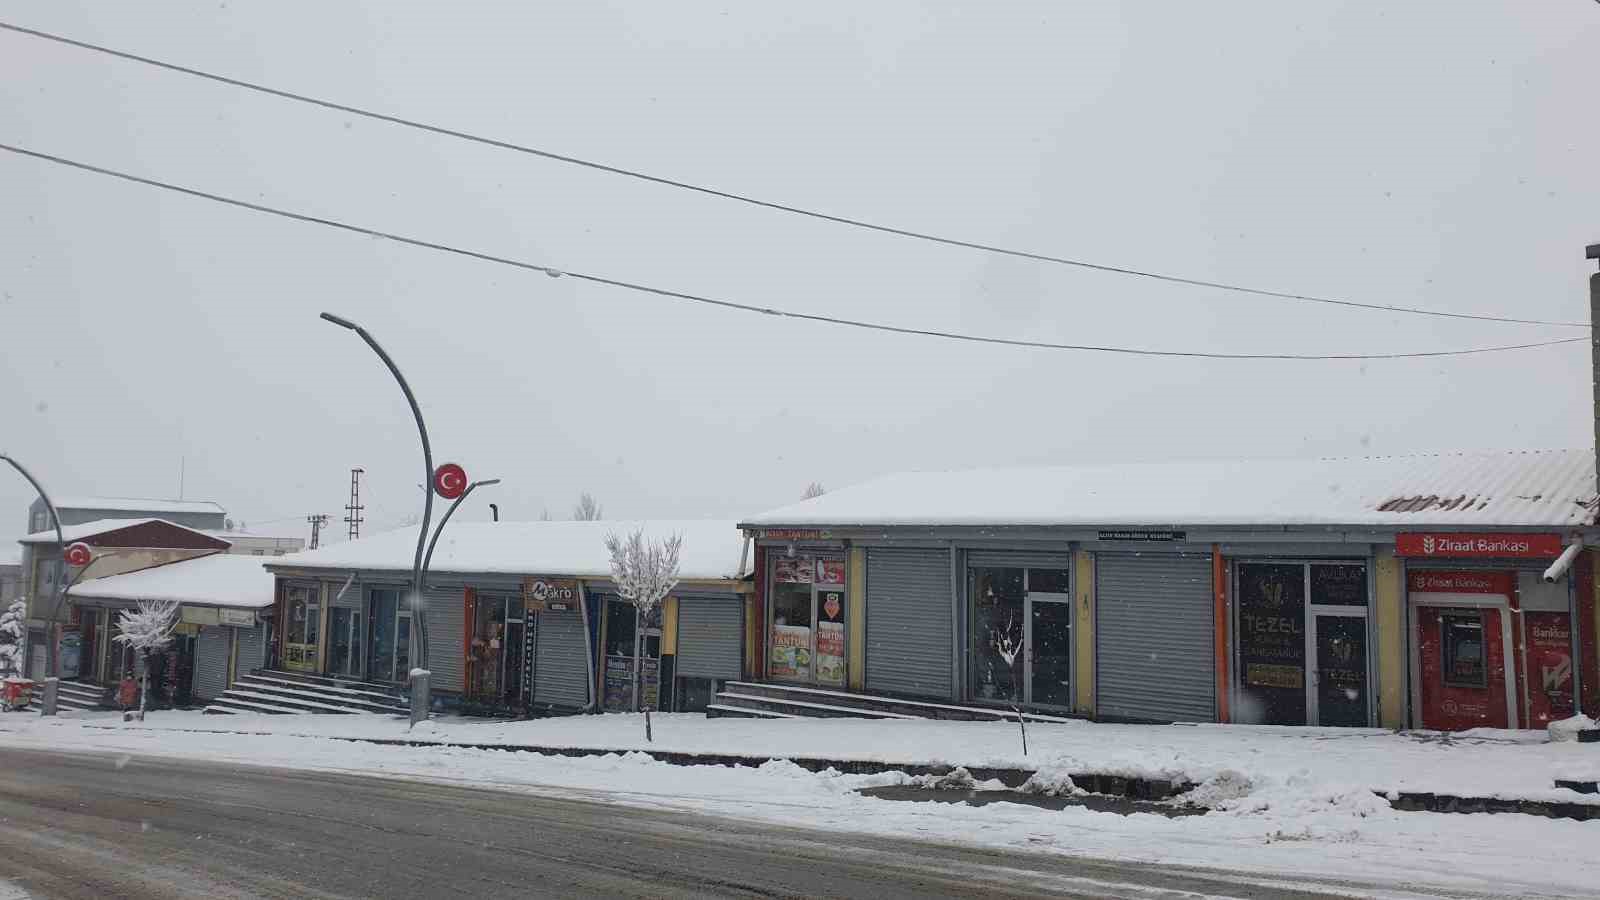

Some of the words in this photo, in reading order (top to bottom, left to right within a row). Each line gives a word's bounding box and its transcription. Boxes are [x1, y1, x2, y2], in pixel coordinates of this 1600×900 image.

[1438, 539, 1474, 552] Ziraat
[1478, 539, 1529, 552] Bankası
[1426, 576, 1454, 588] Ziraat
[1243, 615, 1301, 633] TEZEL
